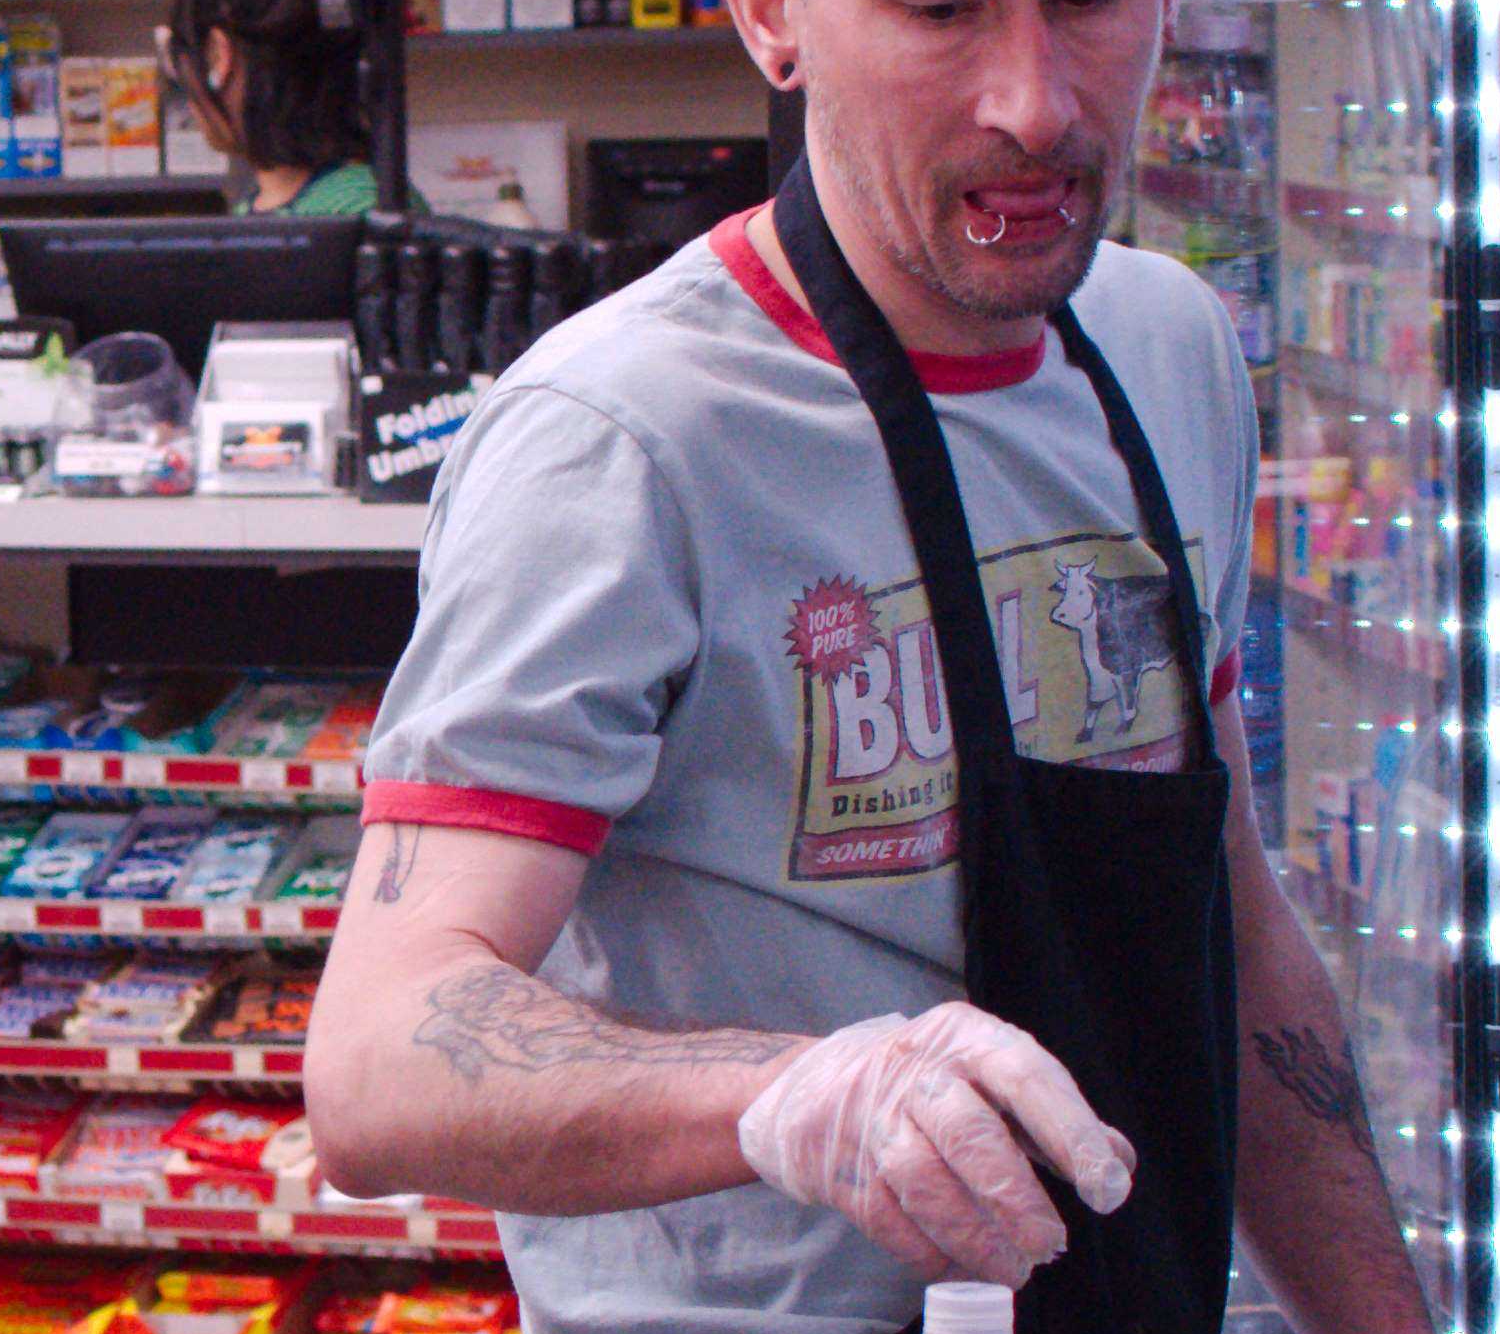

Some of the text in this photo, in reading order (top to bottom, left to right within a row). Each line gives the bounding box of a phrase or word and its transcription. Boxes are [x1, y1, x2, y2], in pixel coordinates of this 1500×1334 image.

[807, 599, 857, 631] 100%
[811, 625, 859, 661] PURE
[831, 779, 935, 819] Dishing
